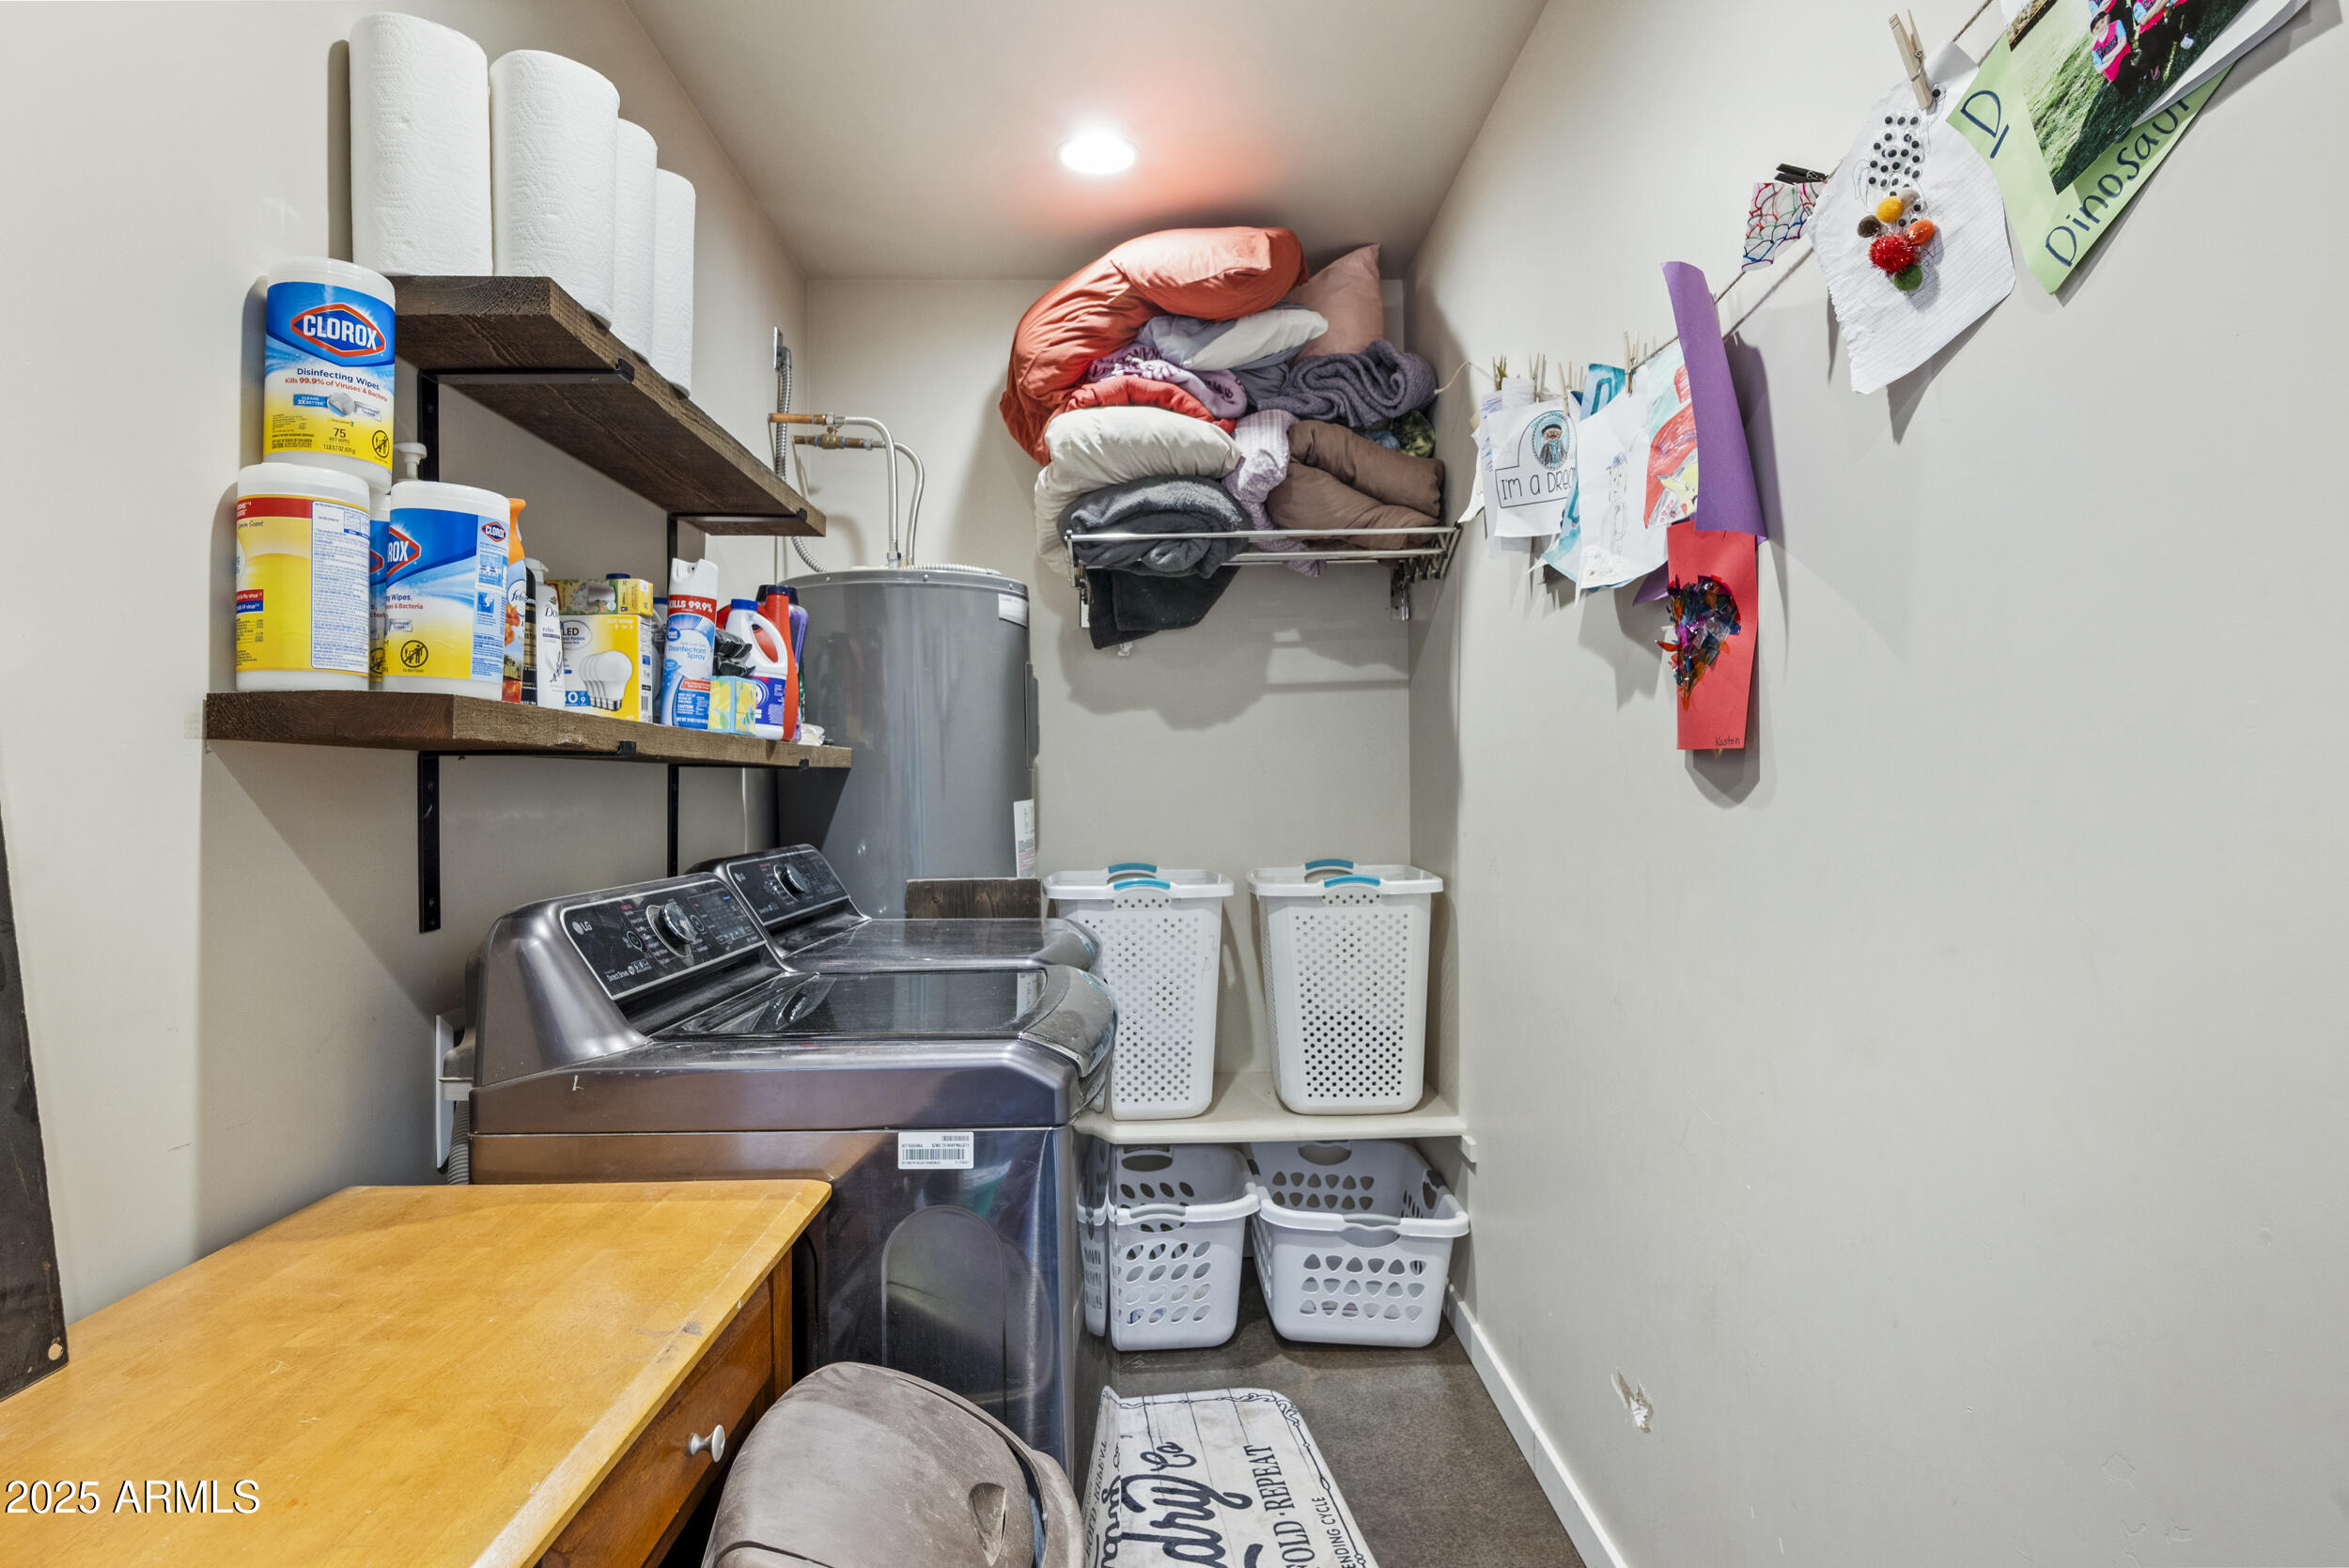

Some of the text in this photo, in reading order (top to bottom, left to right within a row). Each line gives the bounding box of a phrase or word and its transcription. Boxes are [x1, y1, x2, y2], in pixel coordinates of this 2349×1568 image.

[1960, 88, 2004, 140] D
[303, 315, 378, 350] CLOROX
[297, 367, 353, 382] Disinfecting
[299, 377, 324, 385] 99.9%
[334, 381, 361, 392] Viruses
[367, 390, 388, 402] Bacteria
[333, 427, 346, 438] 75
[1501, 477, 1523, 500] I'm
[1530, 474, 1541, 495] a
[485, 525, 505, 538] CLOROX
[387, 540, 410, 563] ROX
[688, 600, 713, 613] 99.9%
[562, 627, 580, 636] LED
[668, 644, 707, 654] Disinfectant
[687, 652, 706, 660] Spray
[581, 921, 593, 933] LG
[1243, 1444, 1296, 1512] REPEAT
[1118, 1474, 1254, 1568] dry
[1311, 1497, 1337, 1526] CYCLE
